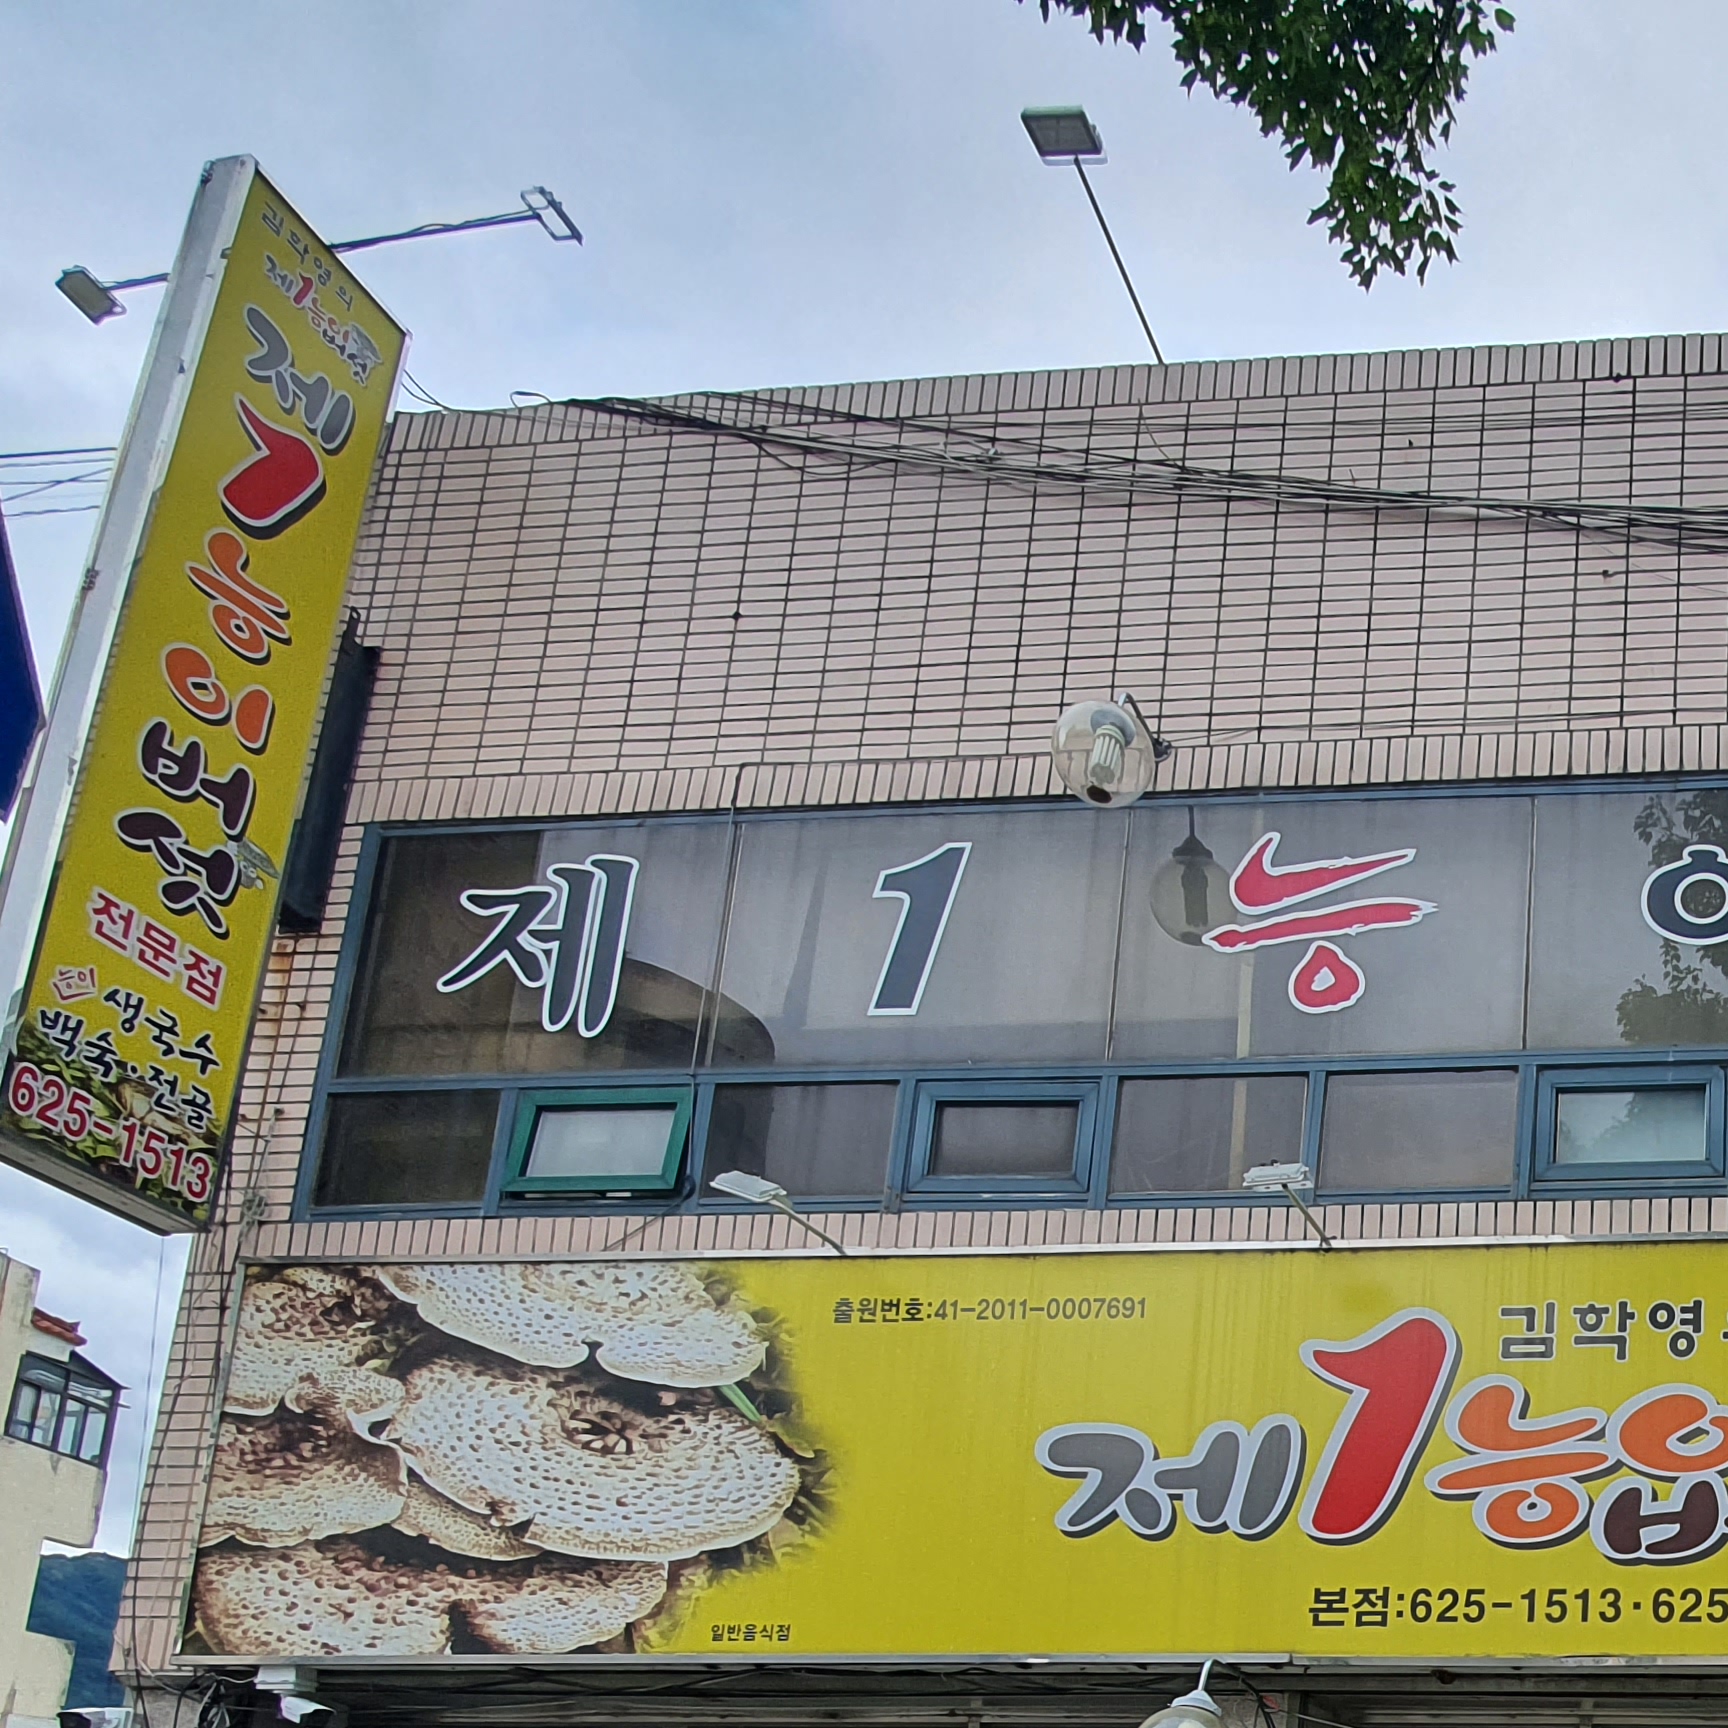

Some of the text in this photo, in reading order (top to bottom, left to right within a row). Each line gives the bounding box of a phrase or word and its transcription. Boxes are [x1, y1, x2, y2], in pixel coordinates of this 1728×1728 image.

[114, 303, 358, 940] 제1능이버섯
[90, 887, 227, 1011] 전문점
[103, 988, 220, 1077] 생국수
[10, 1065, 212, 1203] 625-1513
[832, 1296, 1148, 1325] 출원번호:41-2011-0007691
[711, 1623, 792, 1642] 일반음식점
